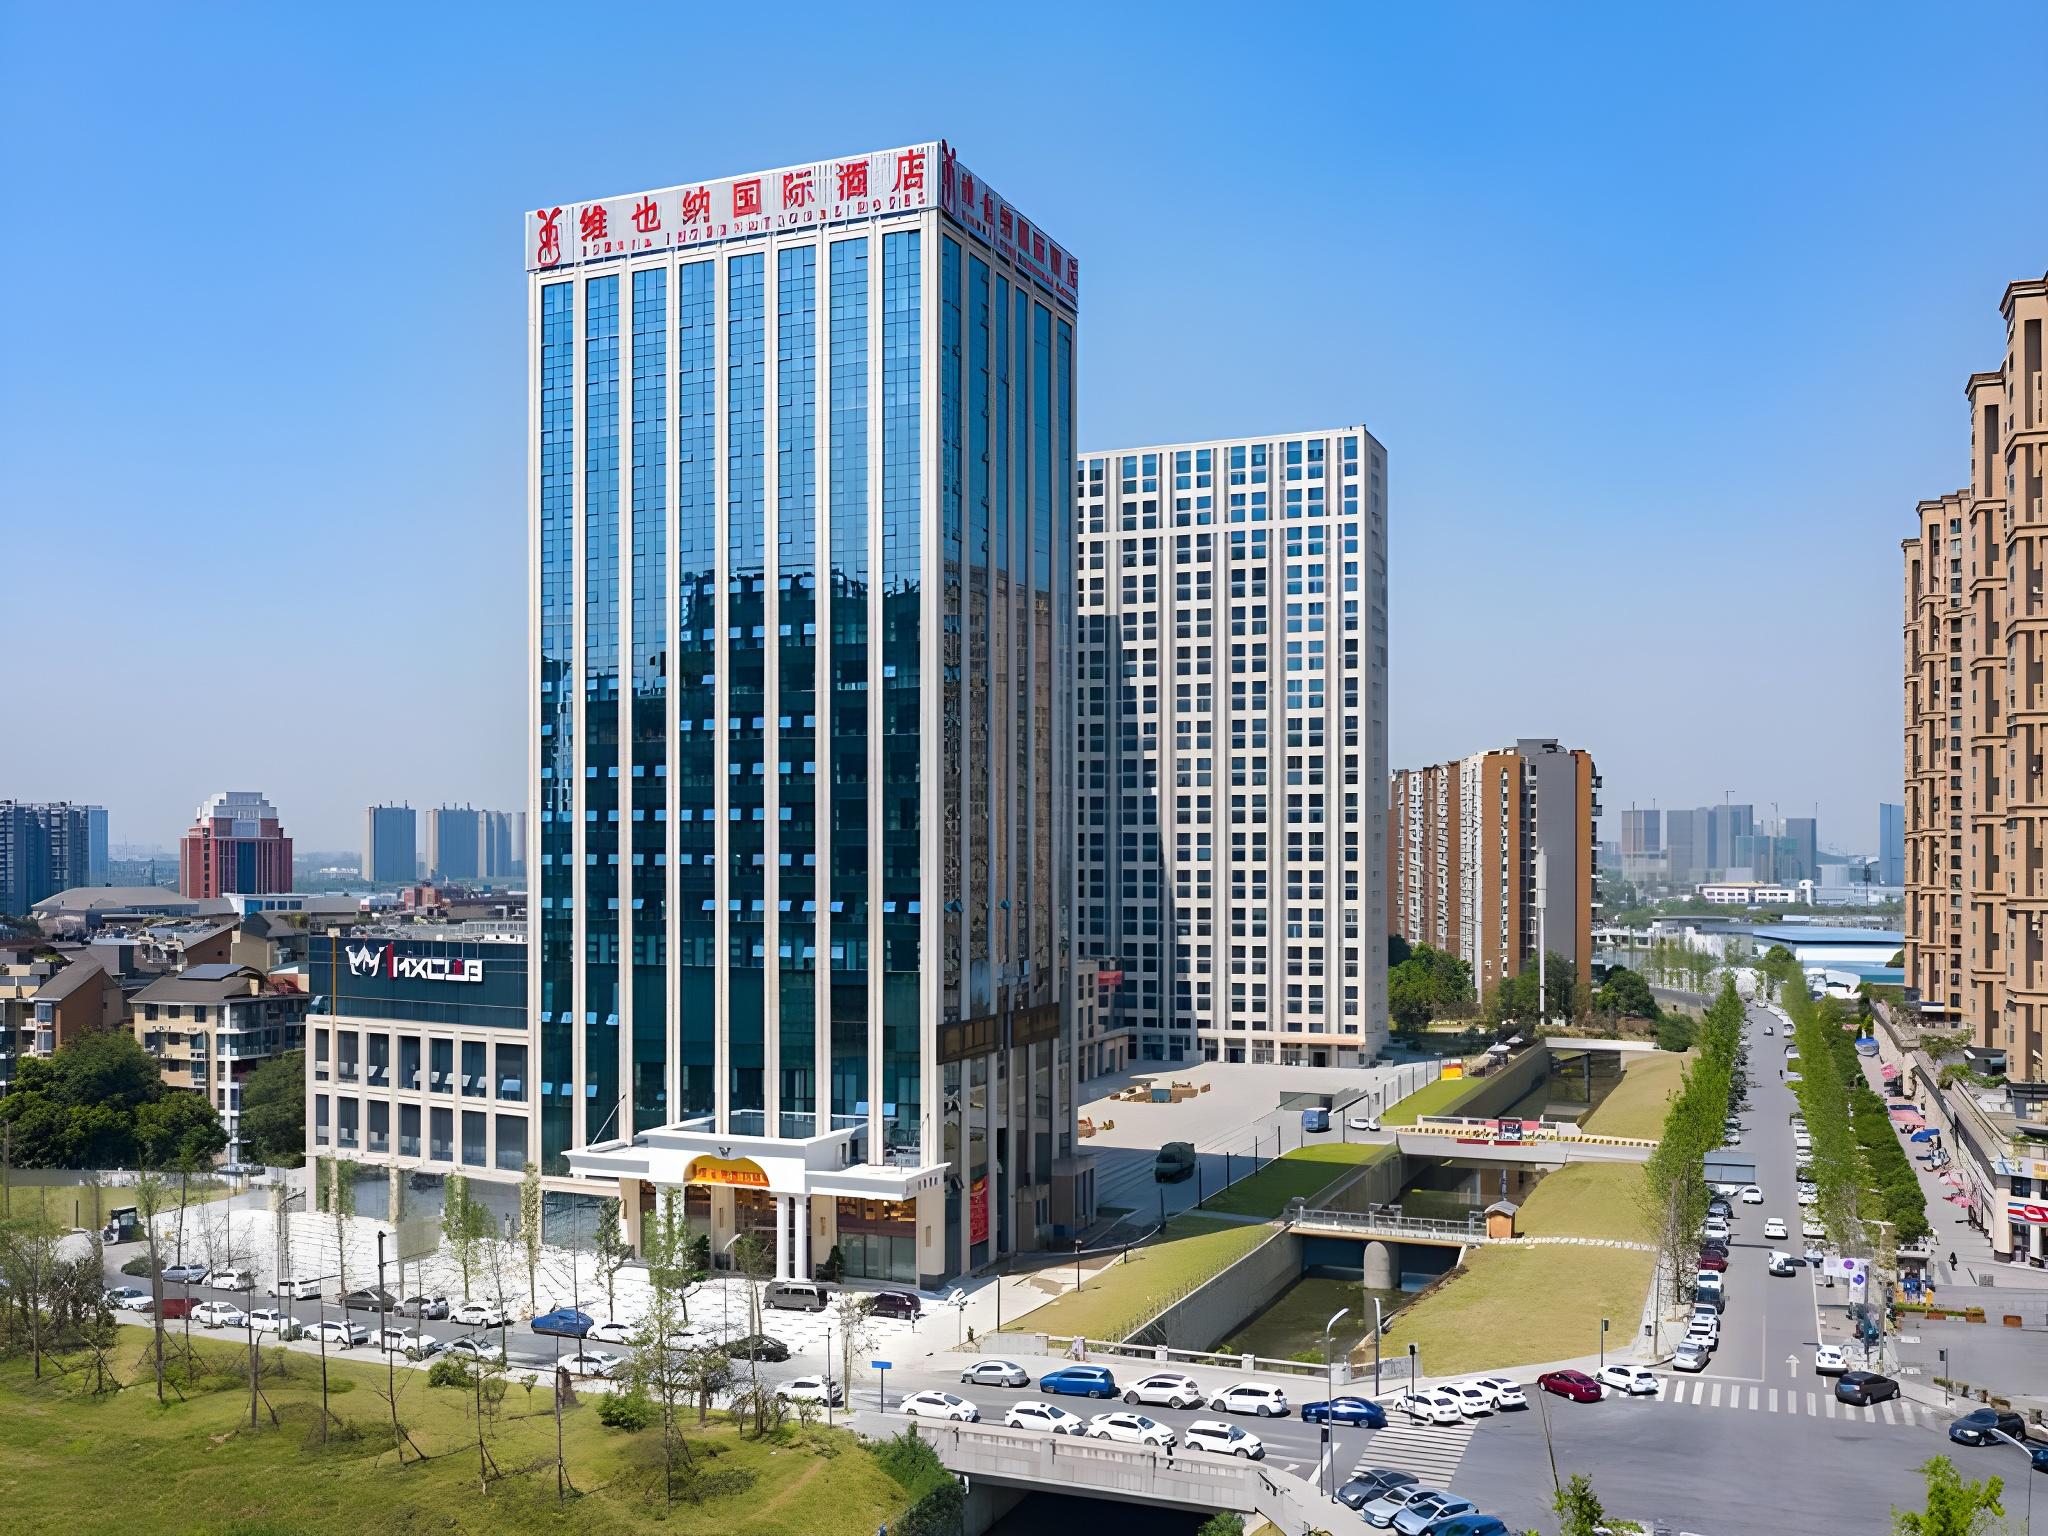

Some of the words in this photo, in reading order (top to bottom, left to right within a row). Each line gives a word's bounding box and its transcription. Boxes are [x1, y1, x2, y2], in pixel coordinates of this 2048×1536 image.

[579, 149, 926, 243] 维也纳国际酒店
